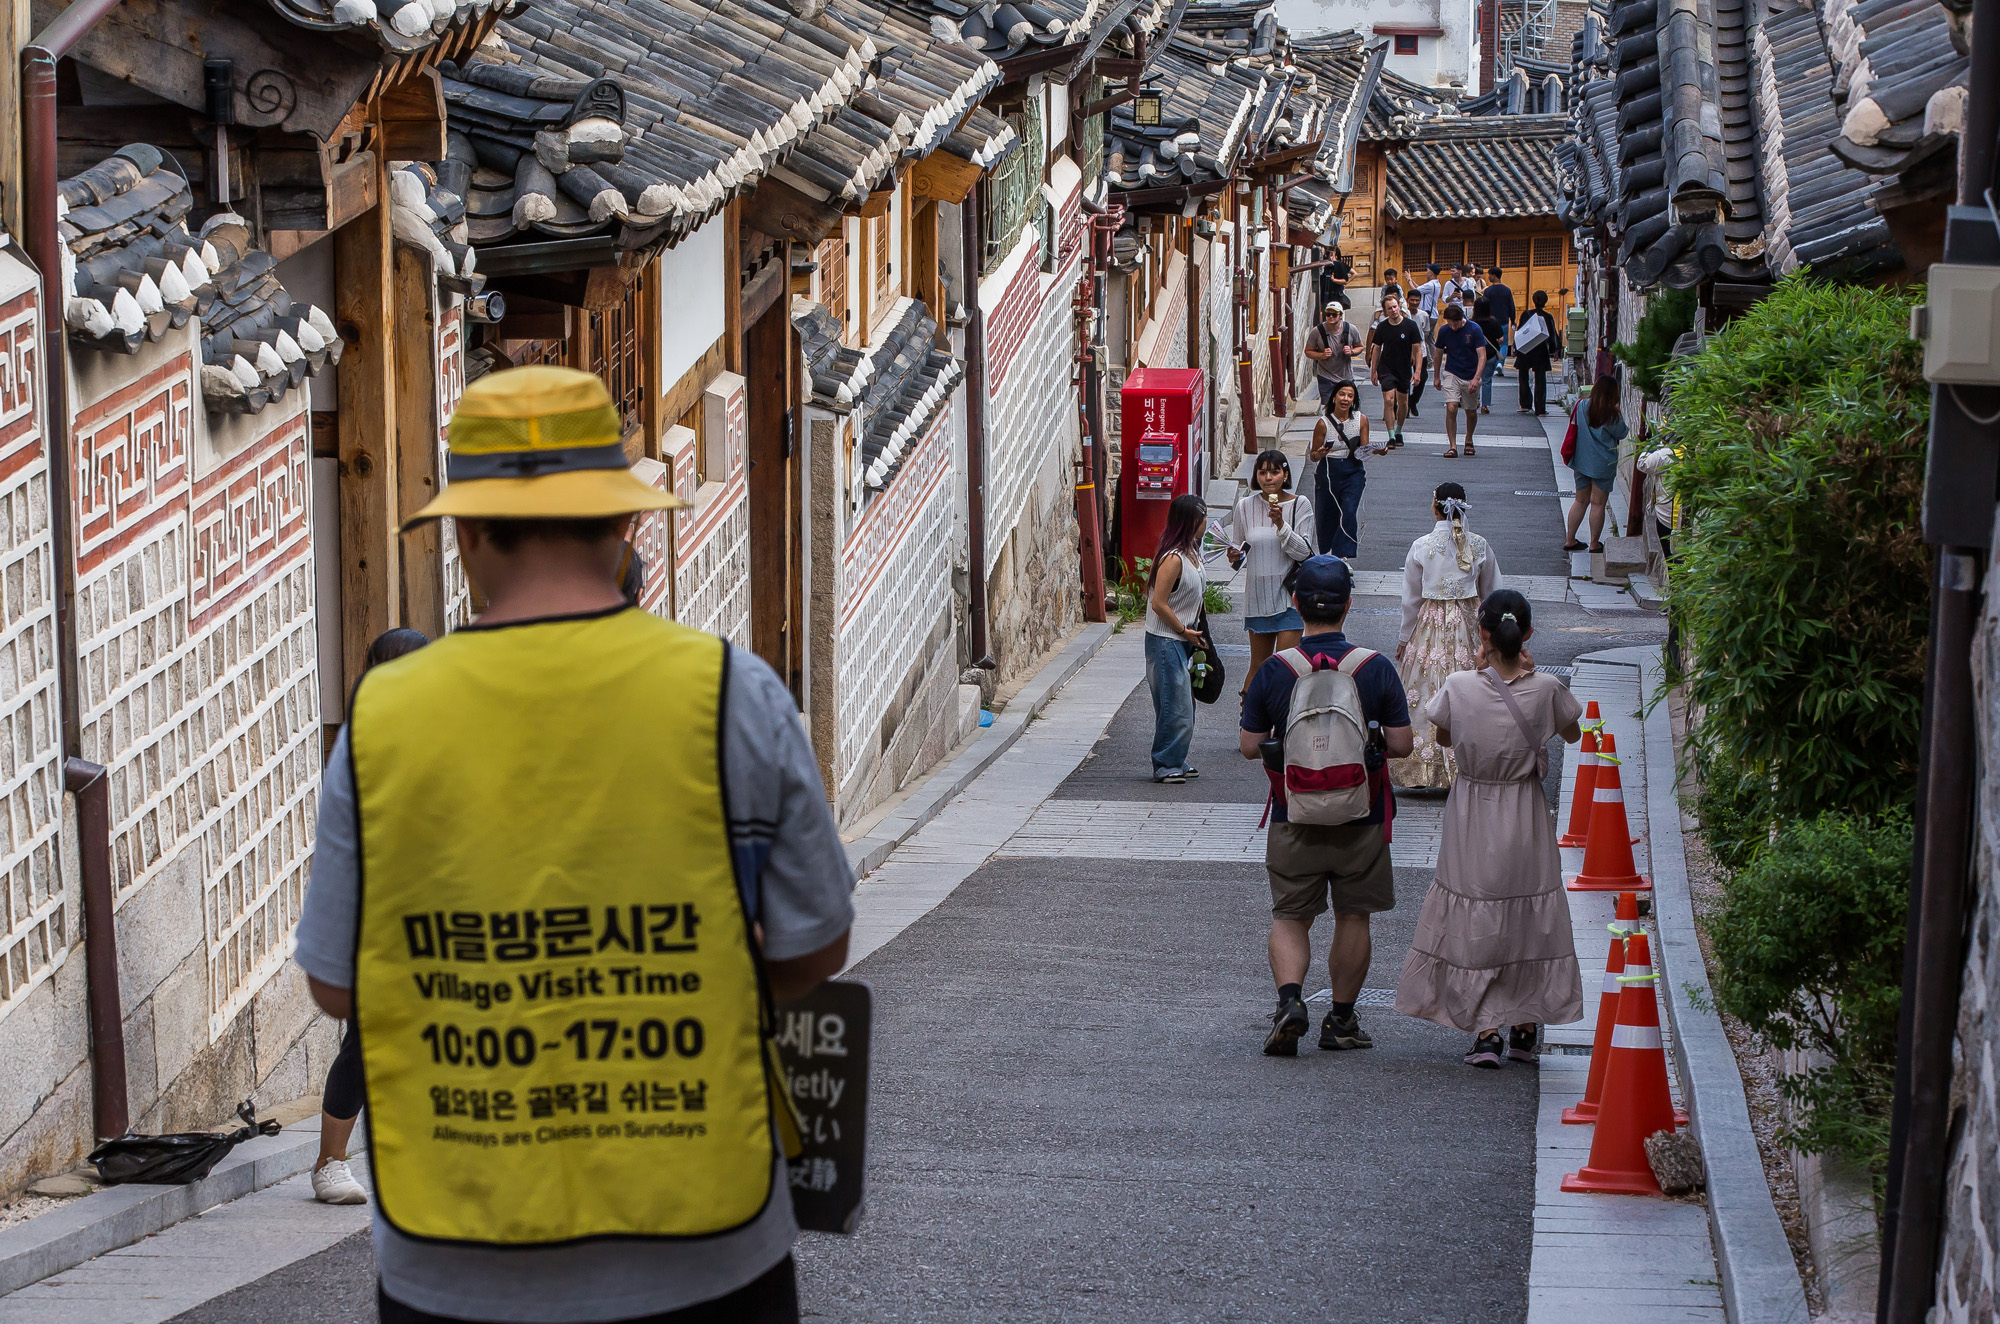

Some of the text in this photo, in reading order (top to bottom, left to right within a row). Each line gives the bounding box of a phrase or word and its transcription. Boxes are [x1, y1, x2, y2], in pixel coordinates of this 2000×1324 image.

[403, 903, 701, 963] 마을방문시간
[413, 965, 701, 1010] Village Visit Time
[420, 1017, 705, 1067] 10:00~17:00
[774, 1011, 848, 1058] 세요
[429, 1079, 708, 1121] 일요일은 골목길 쉬는날
[502, 1130, 532, 1147] are
[596, 1121, 622, 1138] on
[624, 1120, 708, 1140] Sundays
